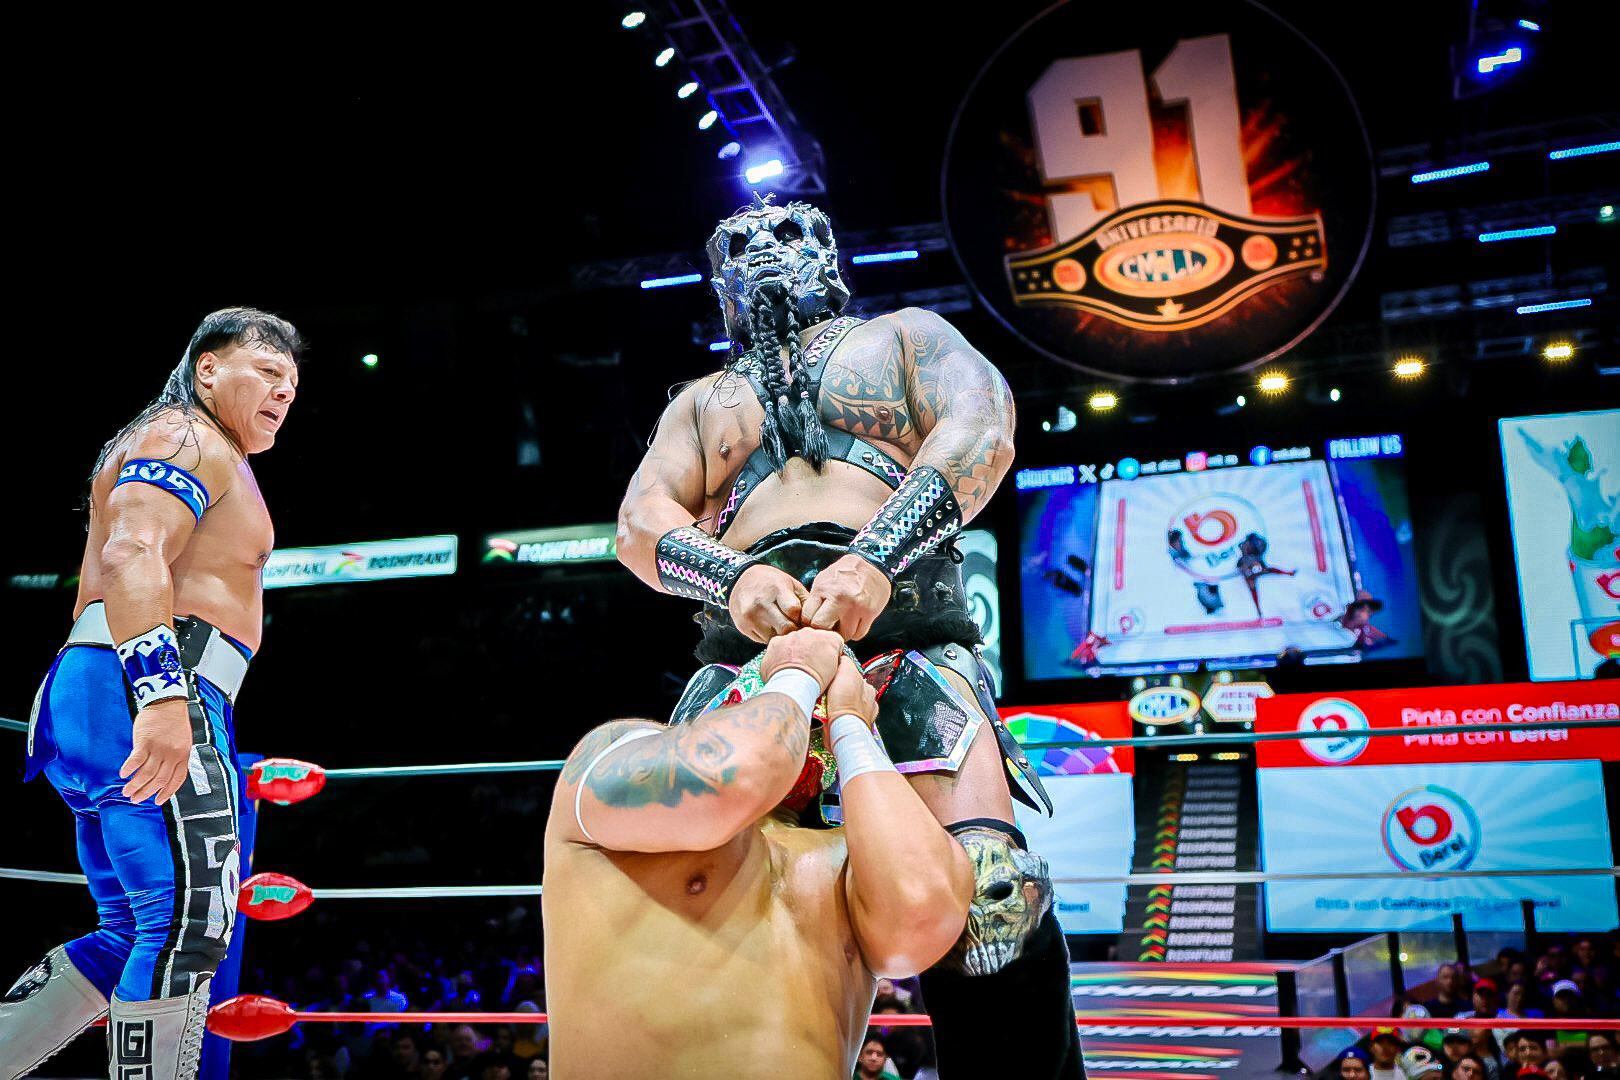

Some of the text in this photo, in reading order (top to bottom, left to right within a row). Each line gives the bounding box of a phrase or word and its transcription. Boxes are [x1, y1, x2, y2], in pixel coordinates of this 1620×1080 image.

[1028, 33, 1252, 244] 91
[1095, 214, 1220, 251] ANIVERSARIO
[1121, 247, 1207, 283] CMLL
[1330, 438, 1379, 458] FOLLOW
[1380, 434, 1401, 454] US
[1401, 701, 1619, 726] Pinta con Confianza
[1419, 833, 1467, 868] Berel
